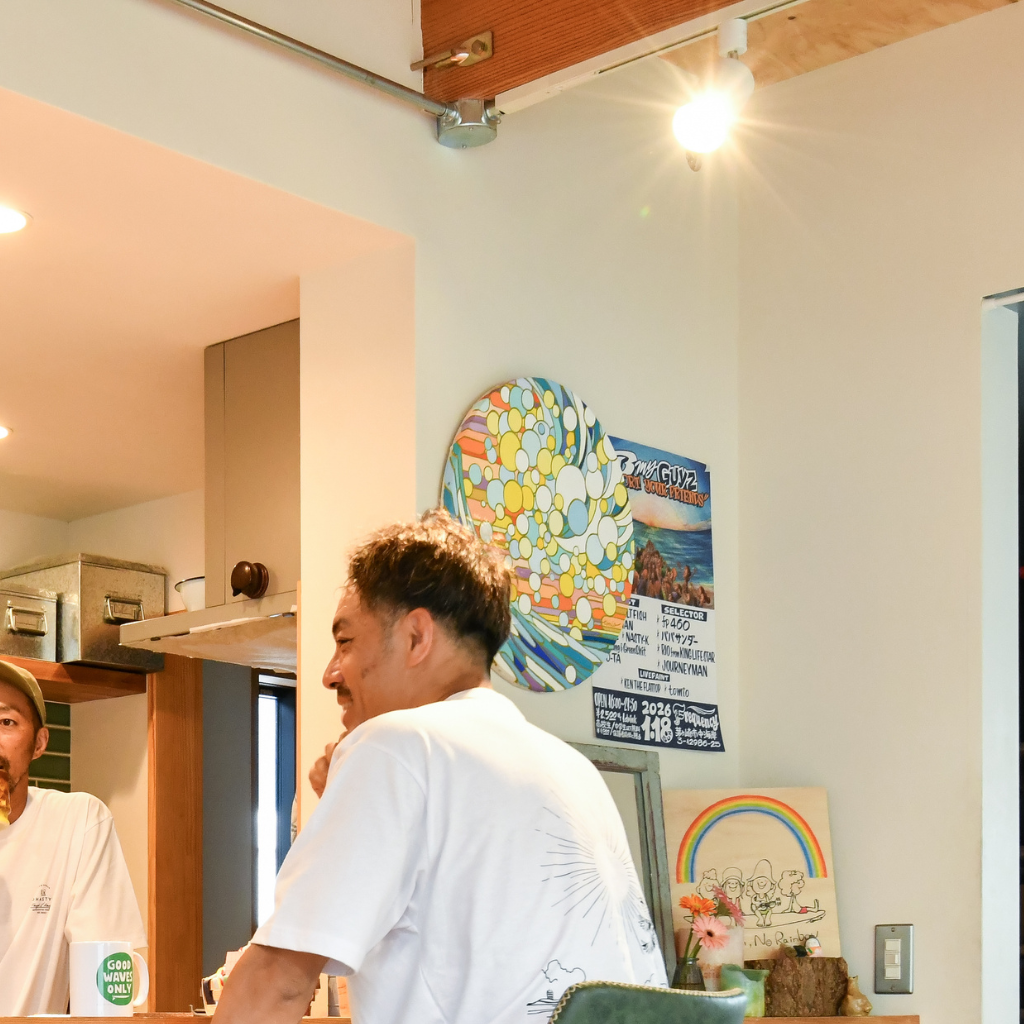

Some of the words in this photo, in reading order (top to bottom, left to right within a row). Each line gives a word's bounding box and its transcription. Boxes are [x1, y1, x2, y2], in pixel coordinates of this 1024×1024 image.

[656, 461, 698, 491] GUYZ
[644, 479, 668, 498] YOUR
[664, 606, 705, 620] SELECTOR
[662, 660, 708, 677] JOURNEYMAN
[668, 685, 689, 698] tomio
[594, 692, 607, 709] OPEN
[641, 700, 671, 717] 2026
[673, 703, 719, 731] Frequency
[641, 715, 673, 743] 1.18
[754, 933, 772, 947] No
[107, 960, 131, 970] GOOD
[103, 971, 133, 982] WAVES
[107, 983, 132, 994] ONLY
